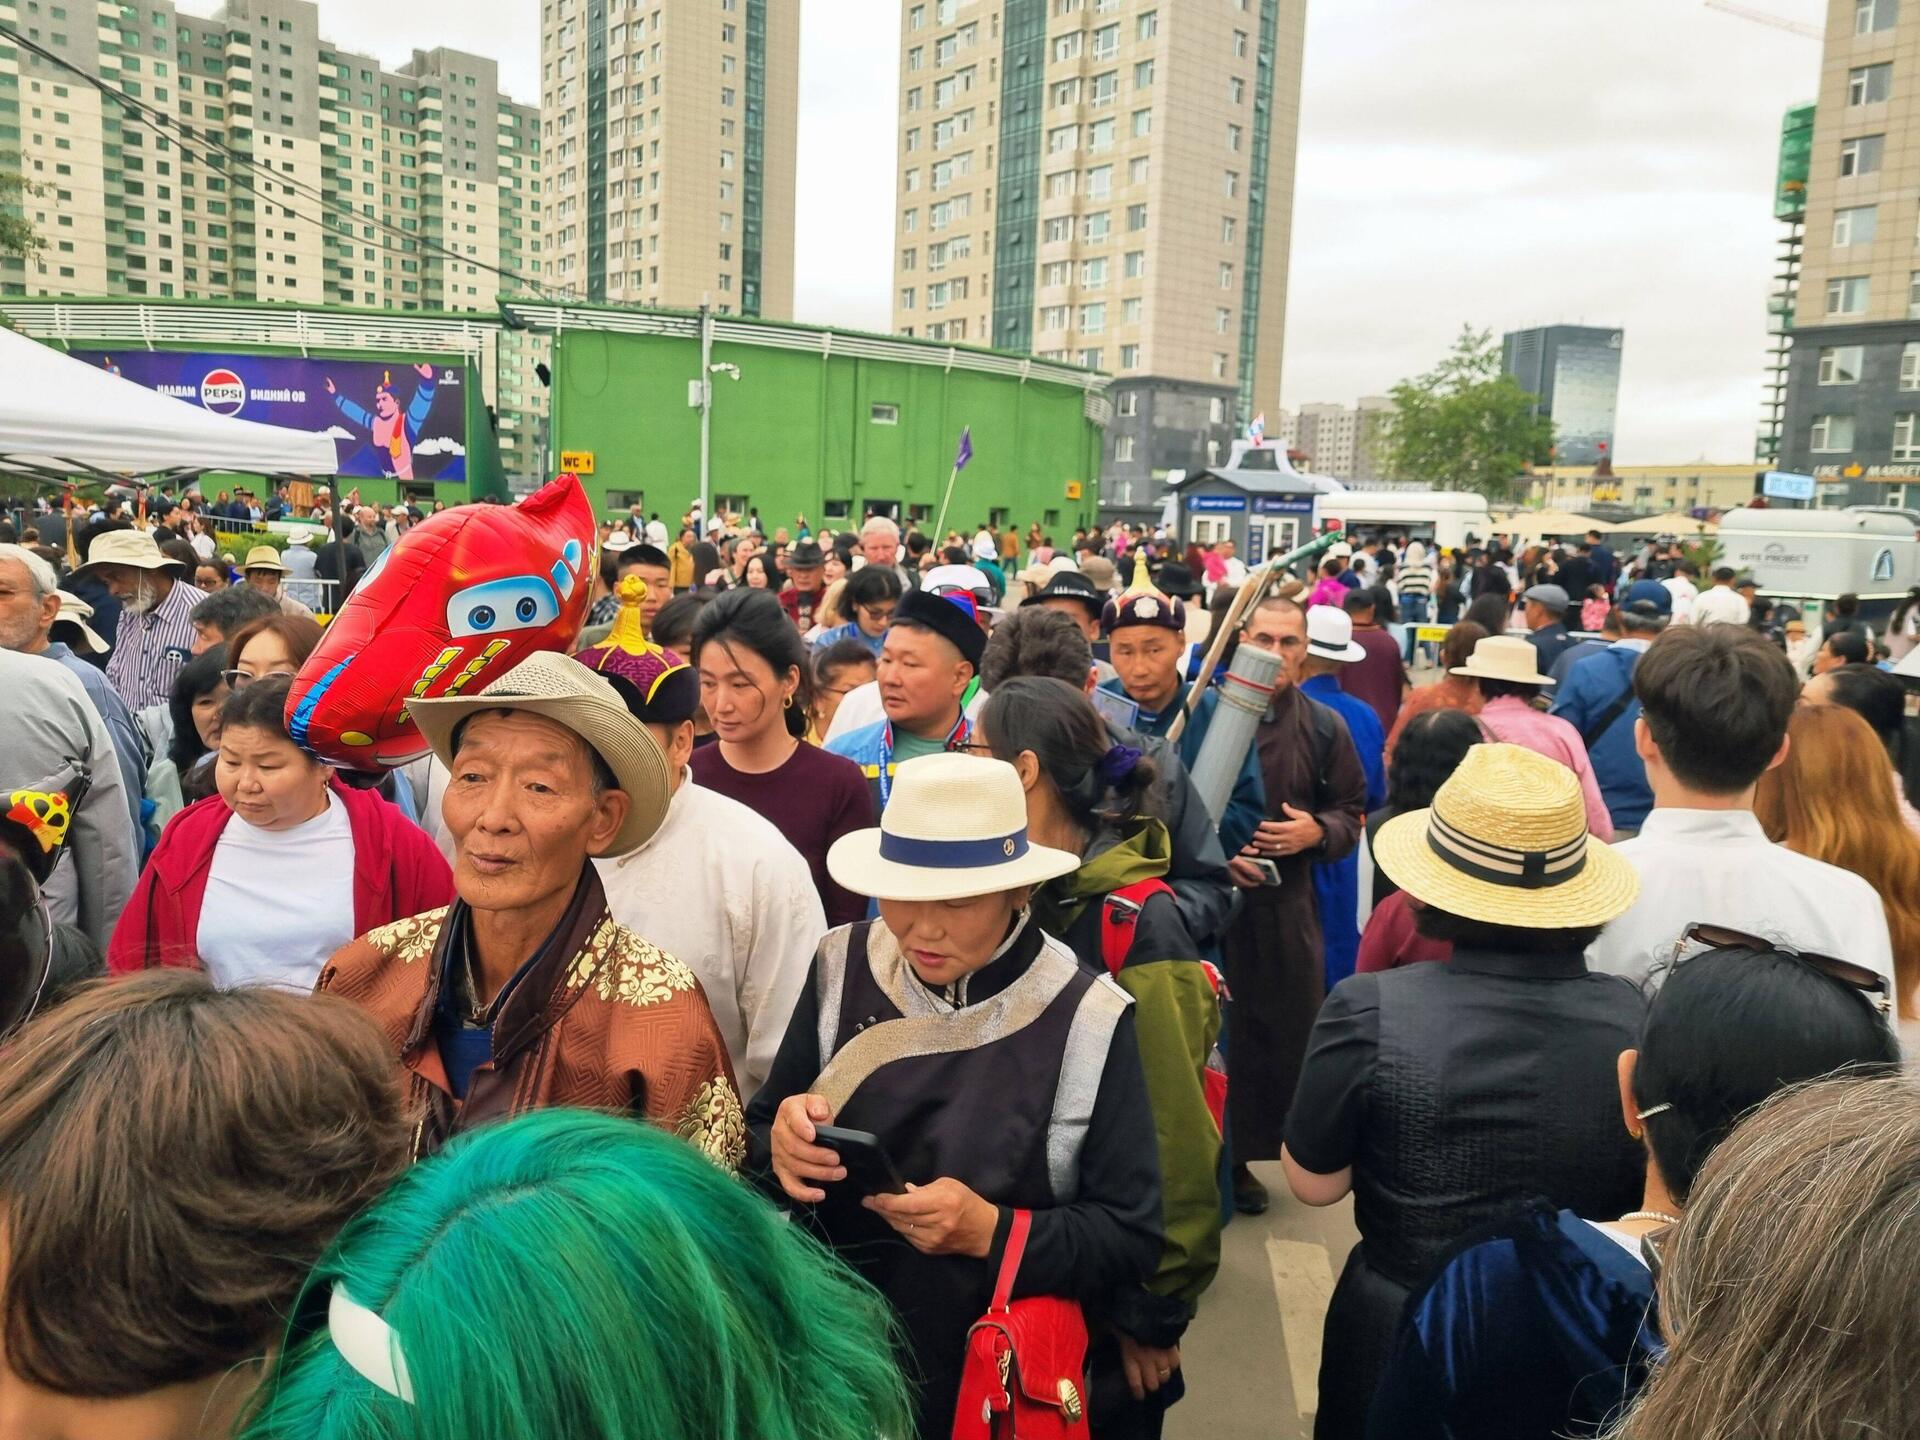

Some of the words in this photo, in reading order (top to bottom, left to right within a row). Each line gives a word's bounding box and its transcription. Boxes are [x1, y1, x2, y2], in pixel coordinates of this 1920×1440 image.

[204, 388, 242, 399] PEPSI
[563, 457, 580, 468] WC
[1812, 465, 1841, 477] LIKE
